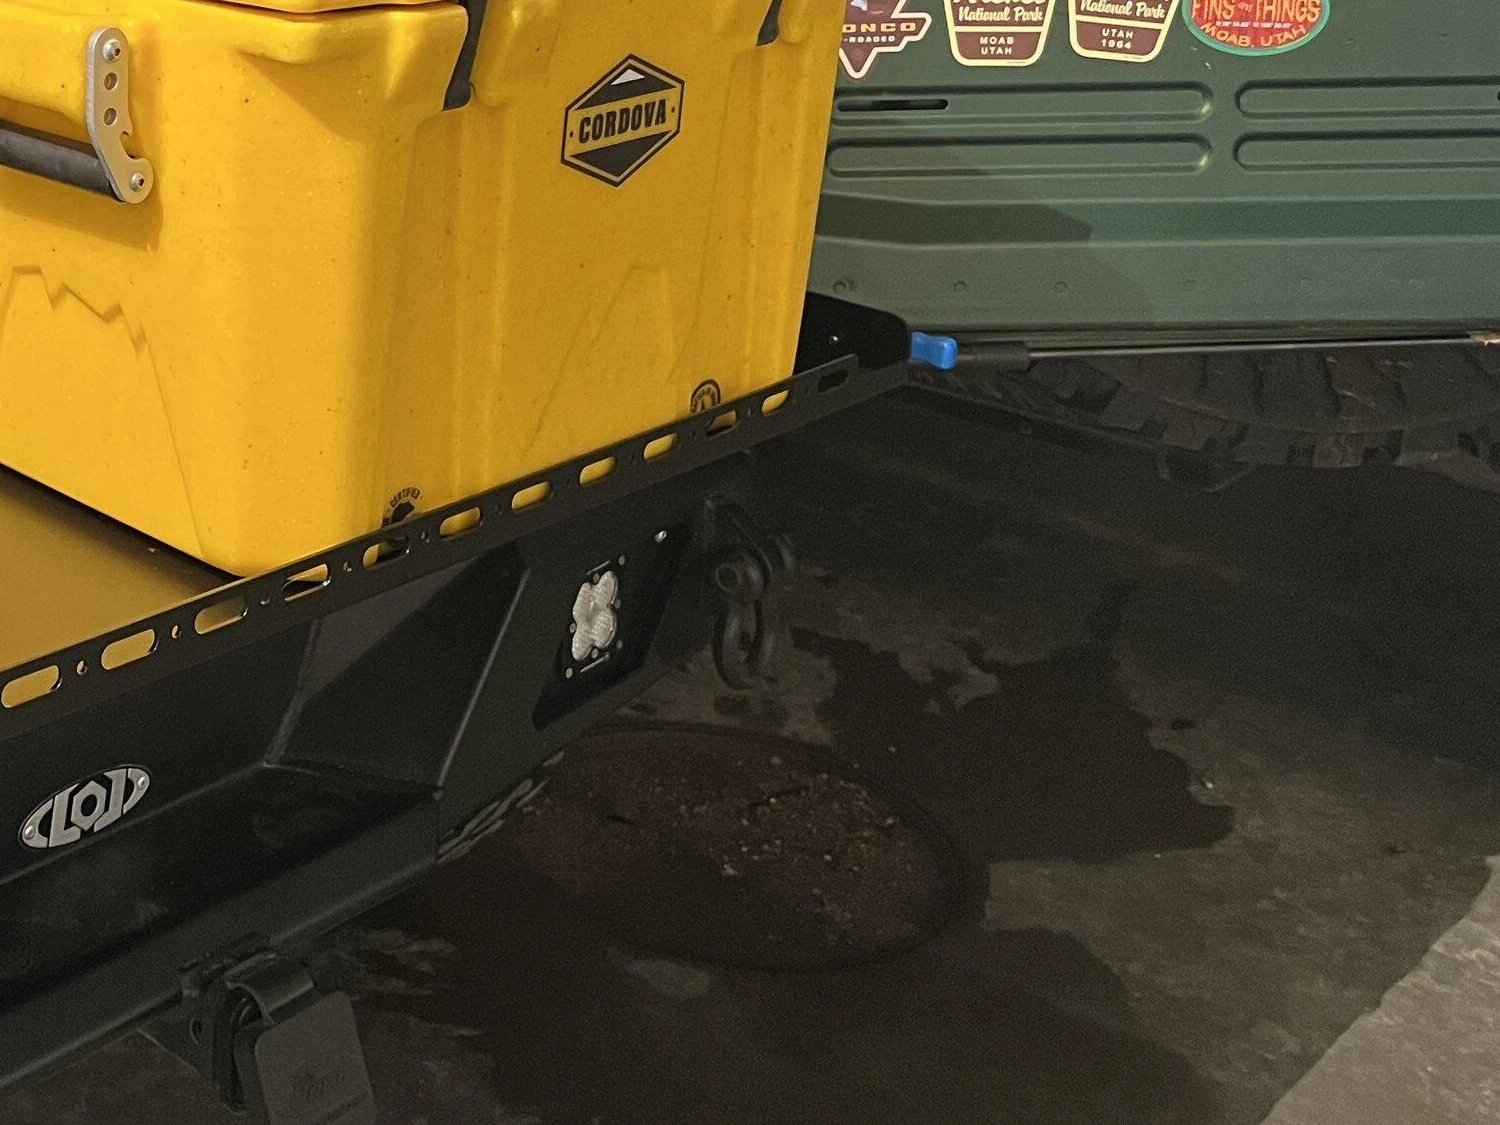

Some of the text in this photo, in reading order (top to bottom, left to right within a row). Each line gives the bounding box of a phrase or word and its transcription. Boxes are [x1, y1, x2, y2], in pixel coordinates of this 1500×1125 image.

[958, 6, 1044, 22] National Park
[1136, 2, 1166, 19] Park
[842, 22, 917, 33] ONCO
[1102, 28, 1134, 39] UTAH
[980, 36, 1014, 45] MOAB
[1260, 25, 1308, 47] UTAH
[981, 47, 1012, 55] UTAH
[578, 98, 667, 144] CORDOVA
